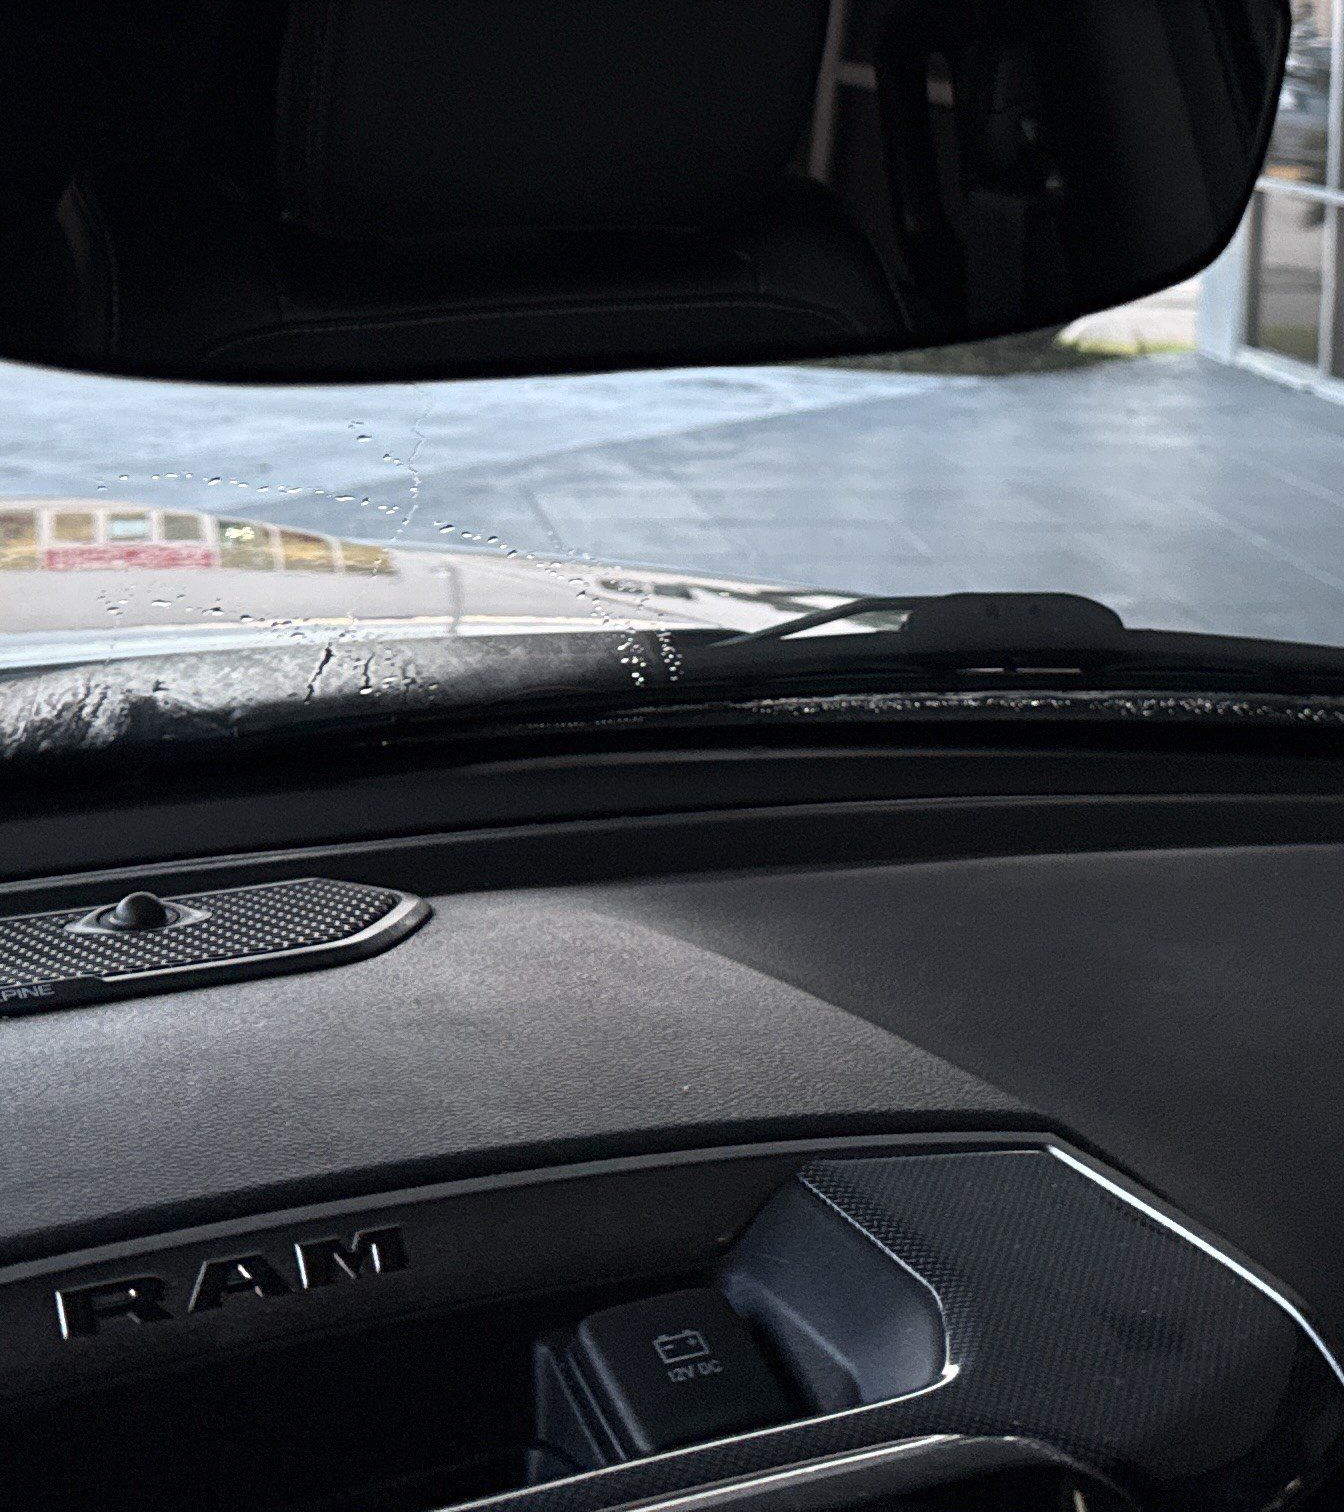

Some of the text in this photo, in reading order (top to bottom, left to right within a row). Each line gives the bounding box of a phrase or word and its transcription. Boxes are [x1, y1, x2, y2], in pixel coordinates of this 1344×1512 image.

[55, 1225, 408, 1339] RAM
[668, 1360, 723, 1382] 12V DC
